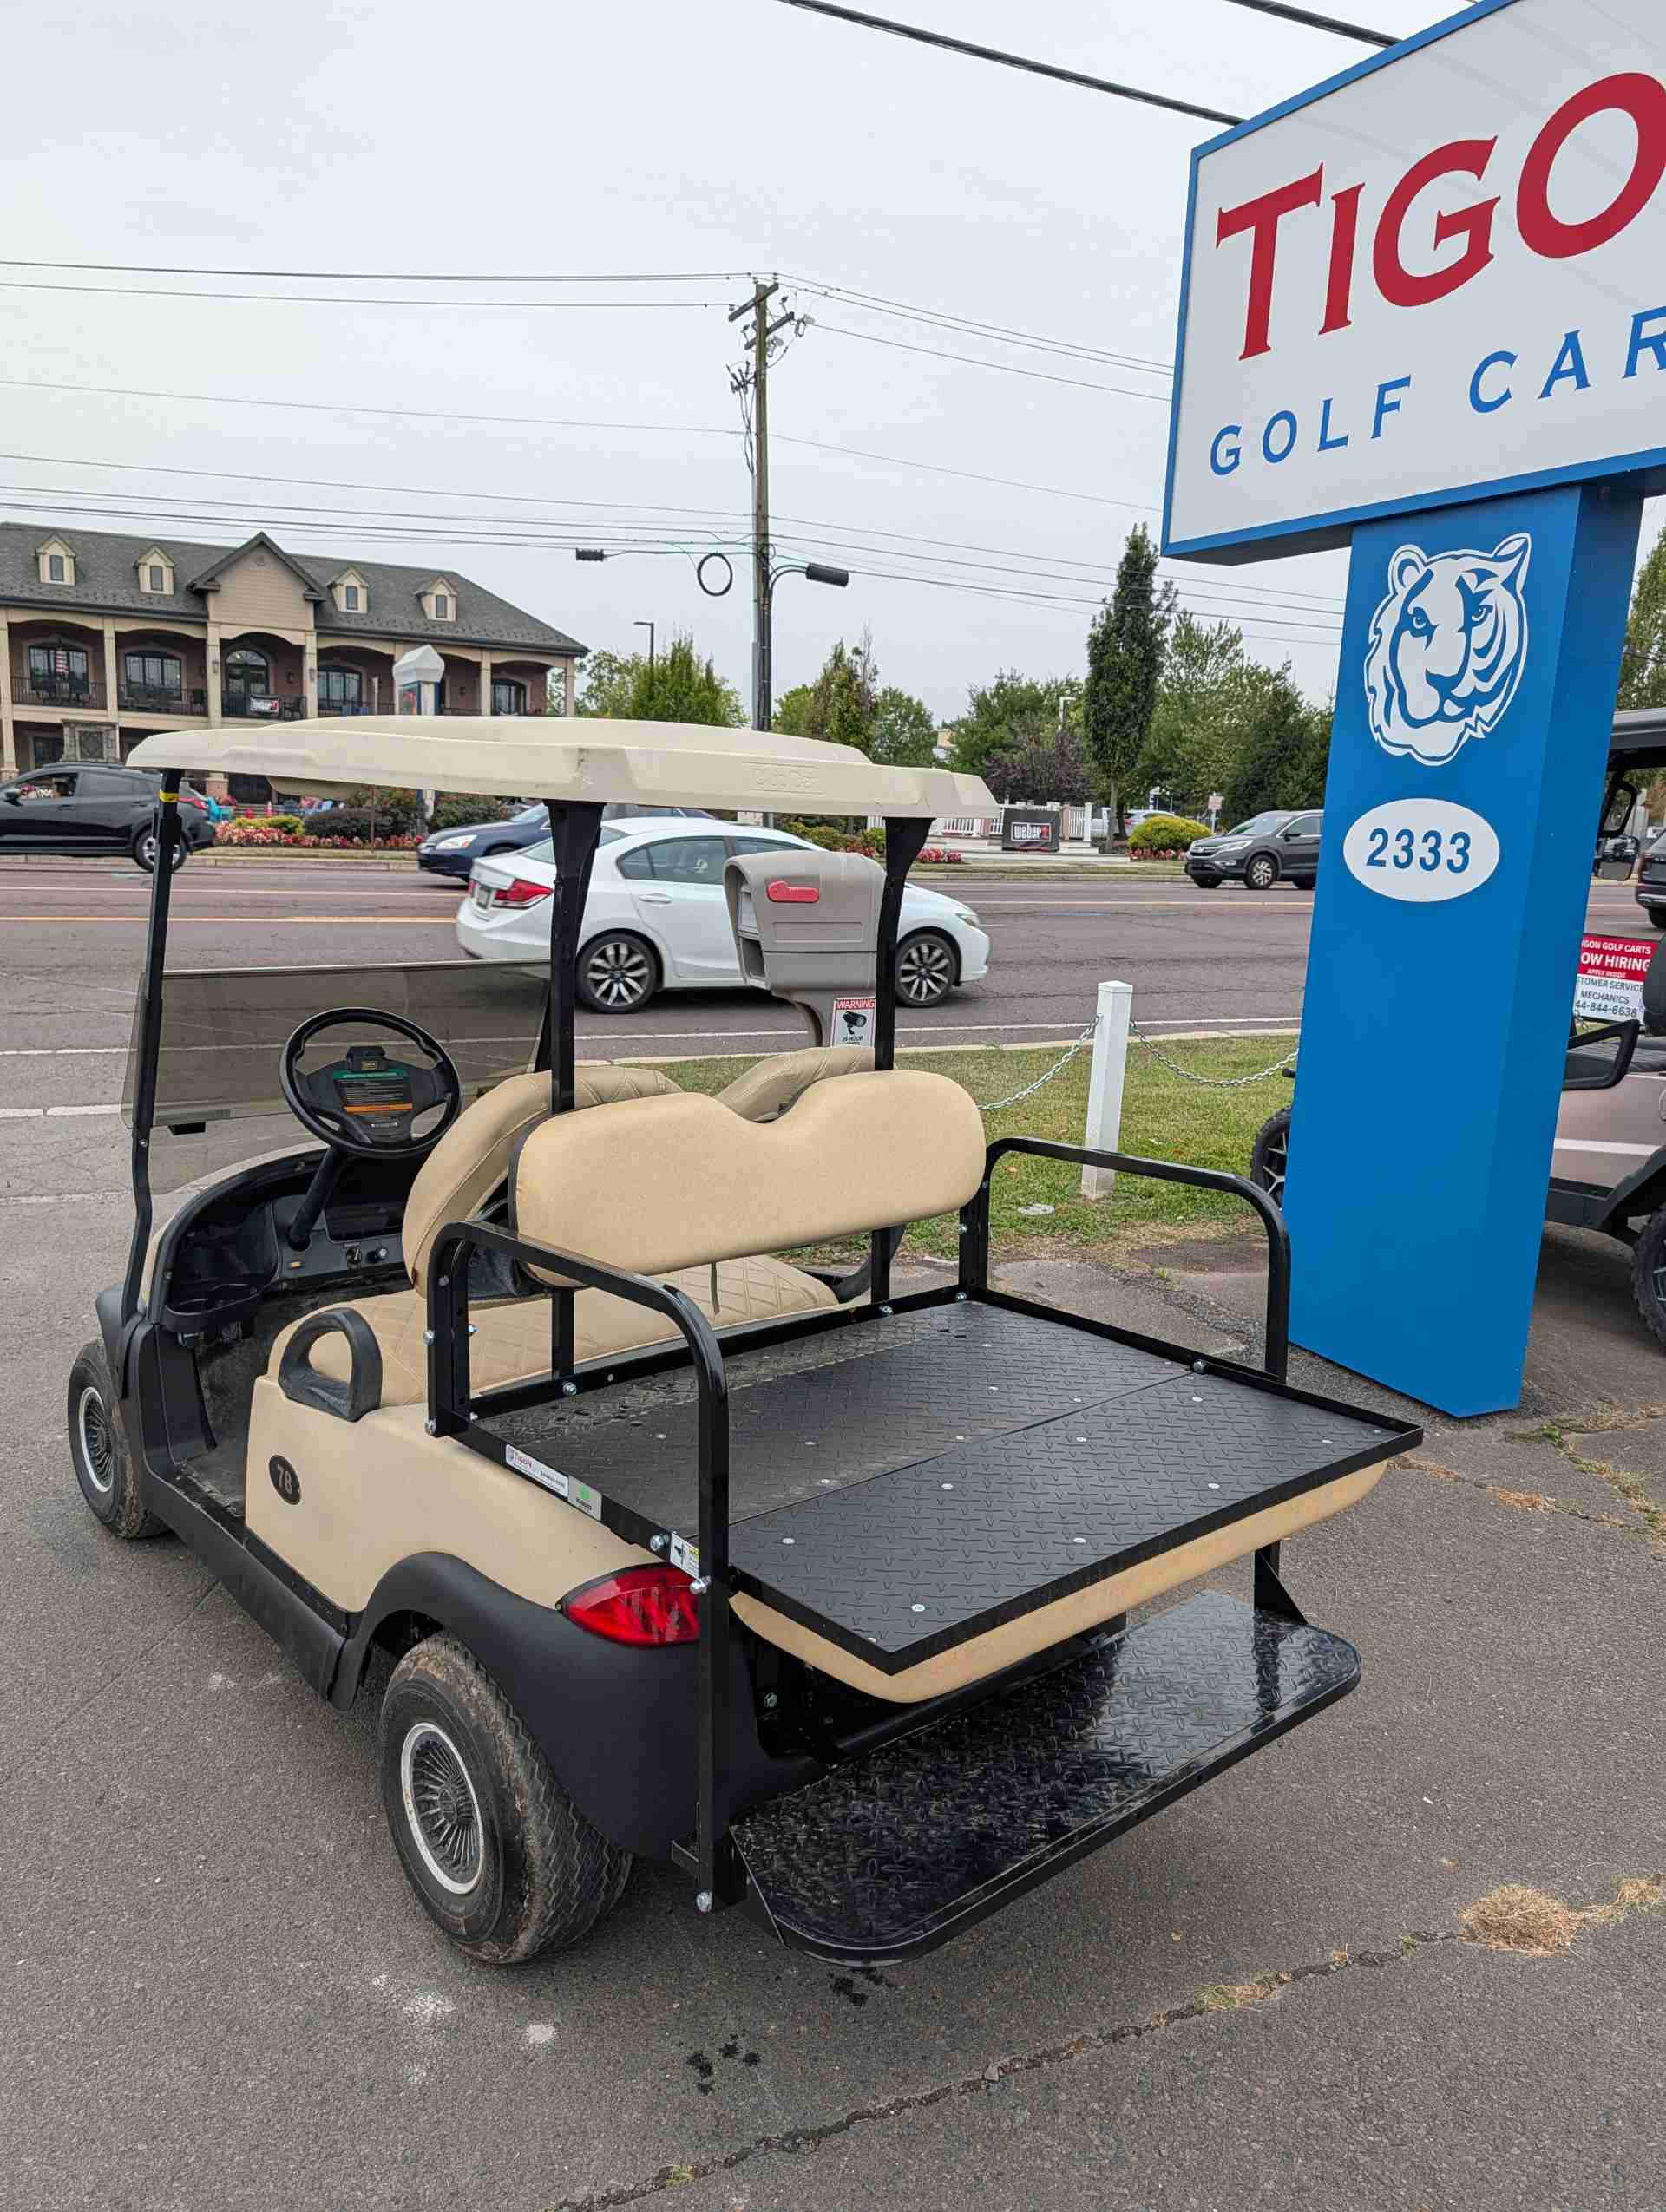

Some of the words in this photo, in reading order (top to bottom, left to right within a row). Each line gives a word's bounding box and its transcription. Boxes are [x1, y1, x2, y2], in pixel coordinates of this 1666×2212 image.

[1210, 375, 1411, 476] GOLF
[1366, 828, 1472, 874] 2333
[1602, 942, 1624, 952] GOLF
[1624, 944, 1652, 955] CARTS
[837, 998, 875, 1010] WARNING
[1581, 990, 1630, 1005] MECHANICS
[276, 1463, 292, 1495] 78
